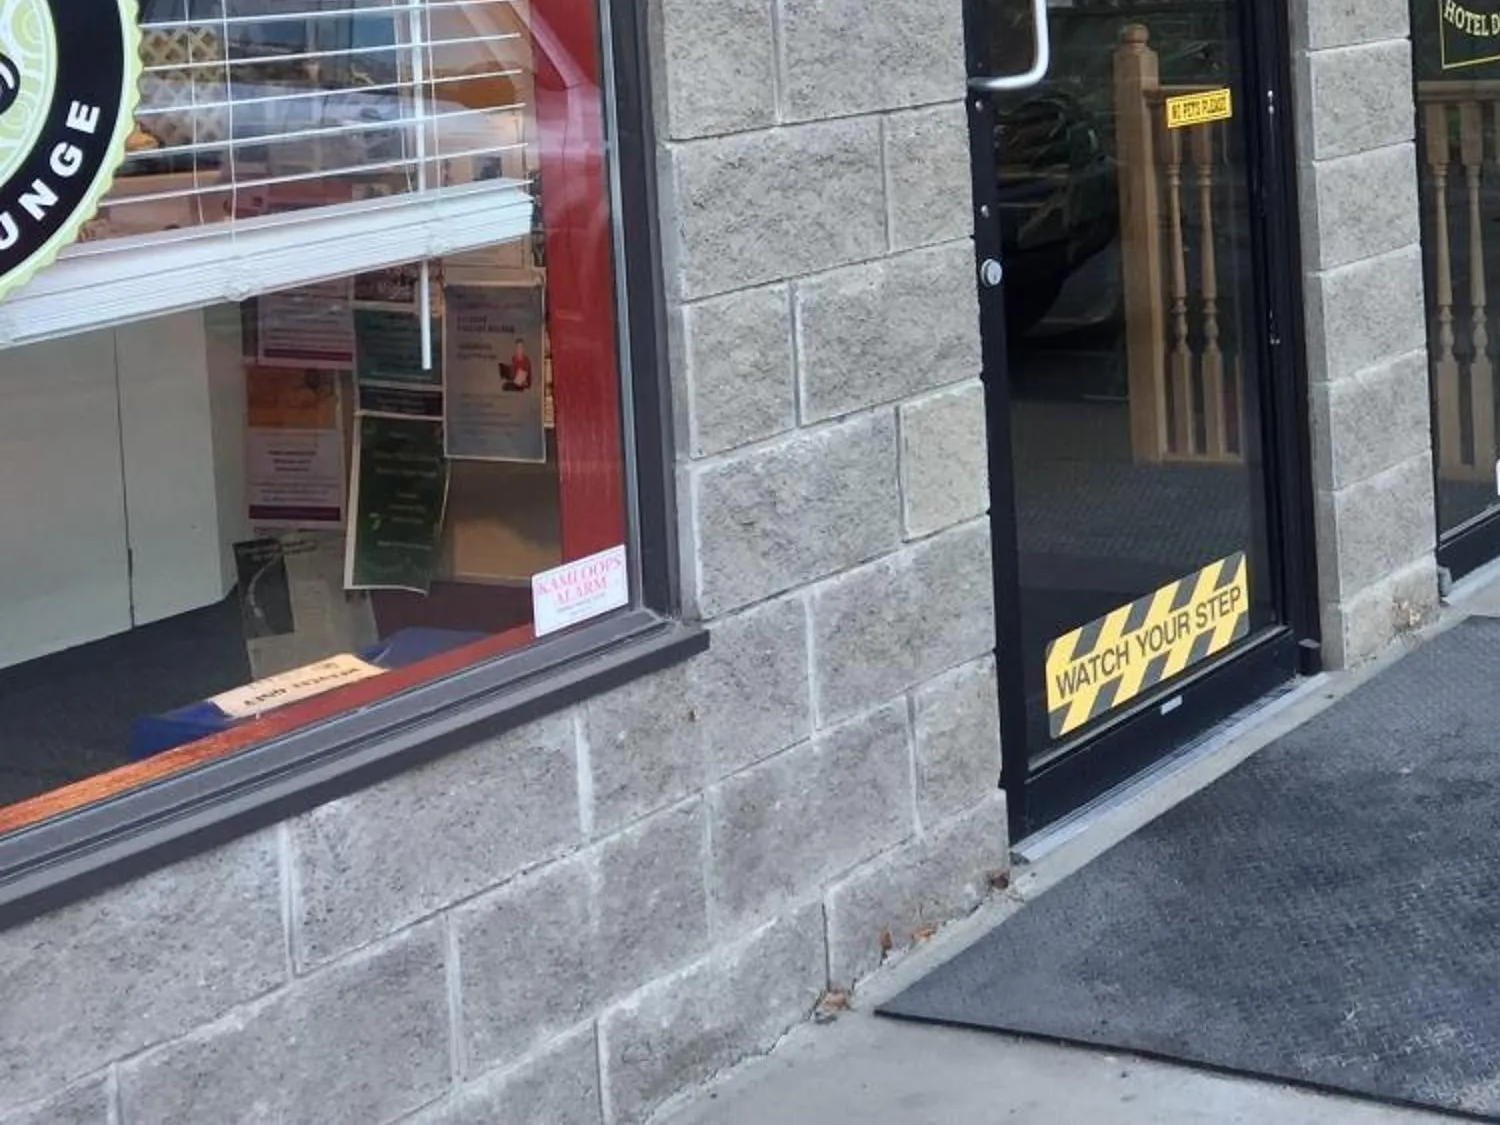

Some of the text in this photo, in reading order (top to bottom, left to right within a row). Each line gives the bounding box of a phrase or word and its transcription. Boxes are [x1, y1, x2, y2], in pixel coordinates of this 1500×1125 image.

[1055, 586, 1242, 700] WATCH YOUR STEP
